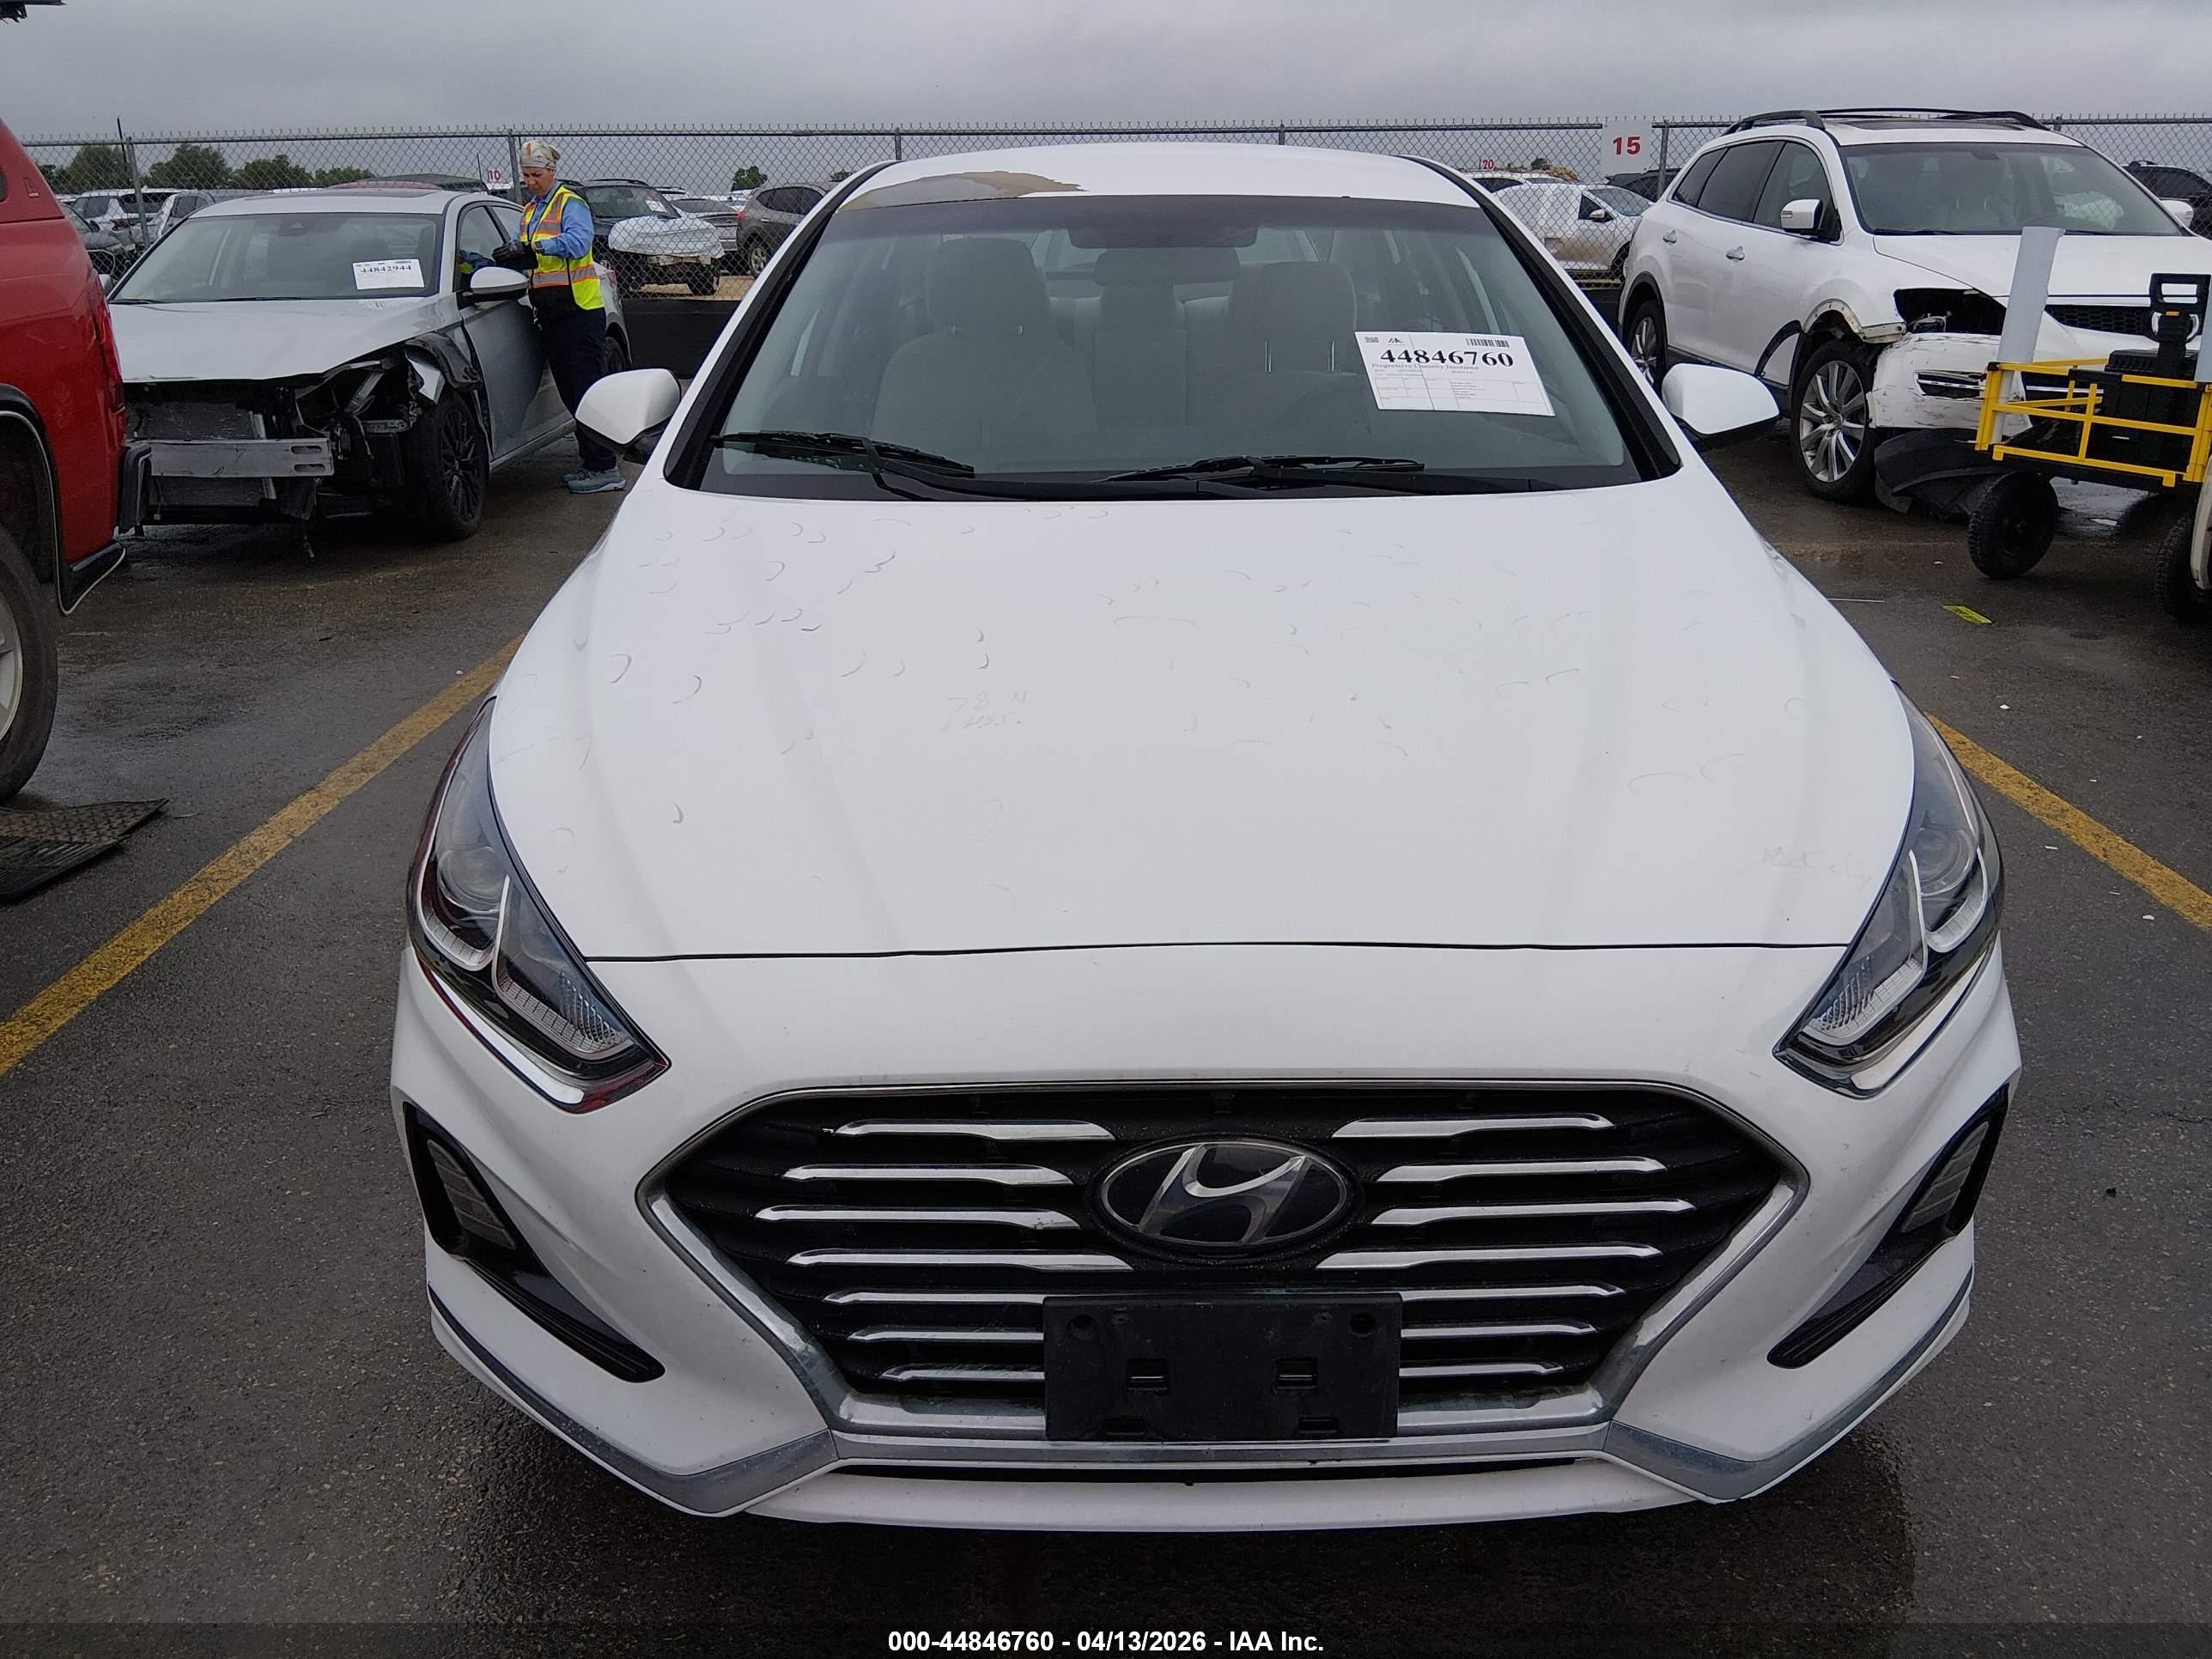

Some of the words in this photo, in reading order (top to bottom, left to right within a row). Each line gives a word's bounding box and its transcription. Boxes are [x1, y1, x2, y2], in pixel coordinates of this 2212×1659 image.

[1613, 136, 1641, 155] 15
[1483, 159, 1494, 169] 20
[489, 170, 501, 180] 10
[361, 264, 411, 273] 44842944
[1380, 349, 1514, 368] 44846760
